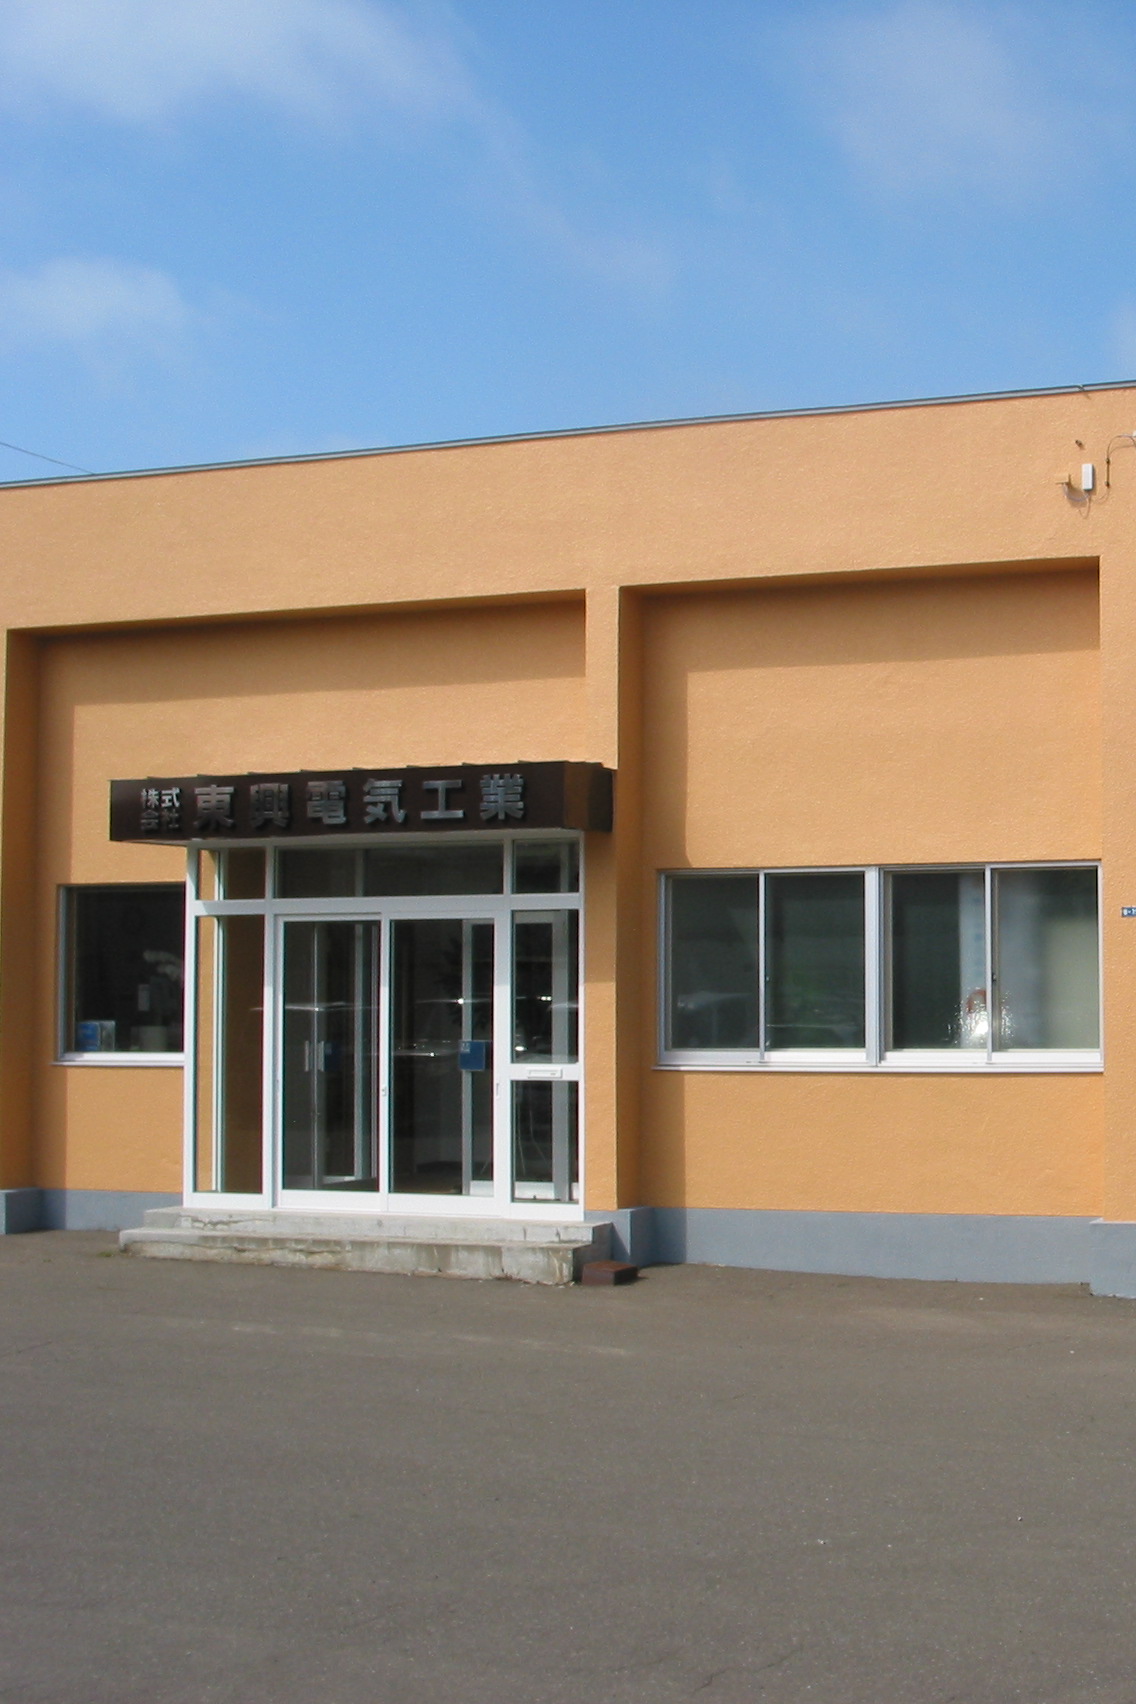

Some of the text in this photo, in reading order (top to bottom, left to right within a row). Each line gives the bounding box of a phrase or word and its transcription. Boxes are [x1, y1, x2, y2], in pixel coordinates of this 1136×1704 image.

[141, 787, 181, 808] 株式
[193, 773, 525, 829] 東興電気工業
[140, 808, 180, 831] 会社
